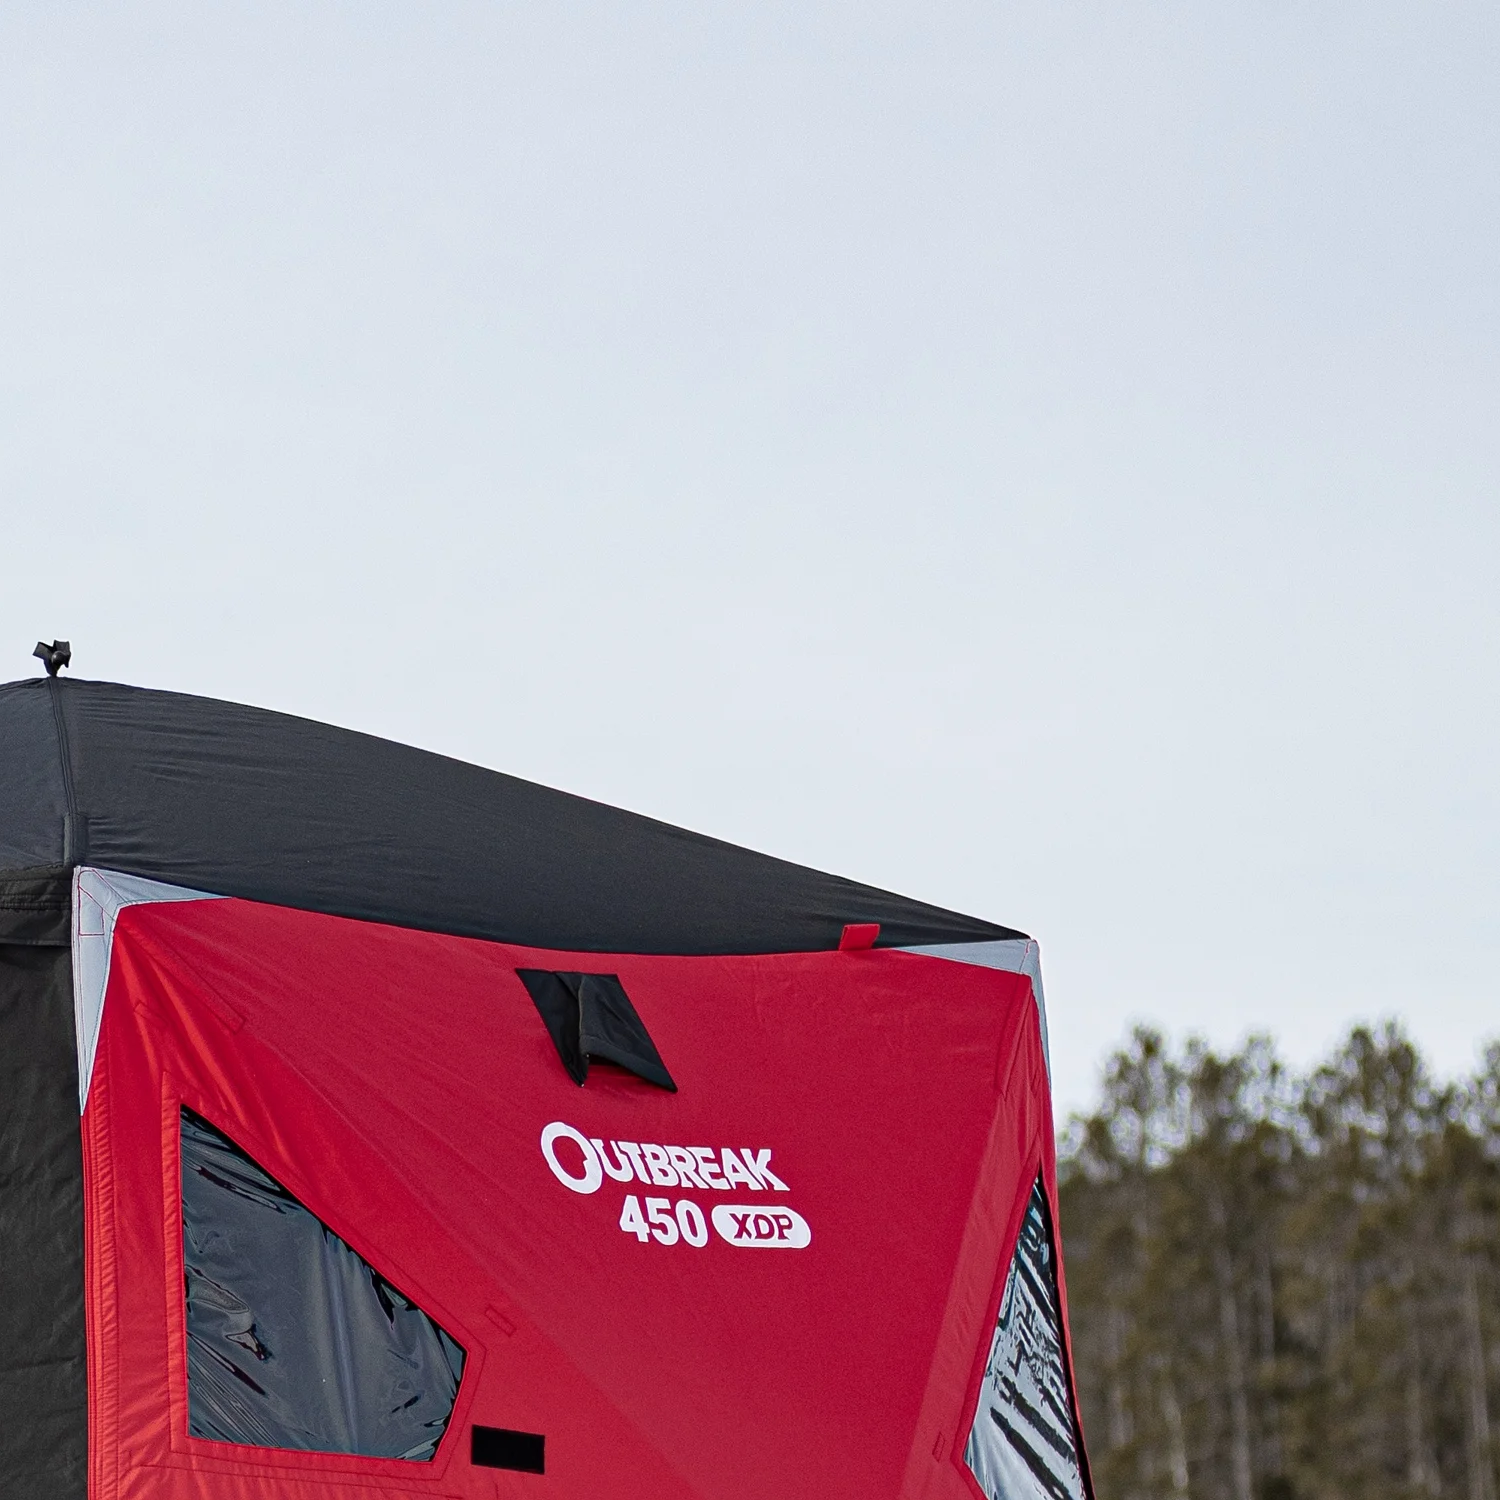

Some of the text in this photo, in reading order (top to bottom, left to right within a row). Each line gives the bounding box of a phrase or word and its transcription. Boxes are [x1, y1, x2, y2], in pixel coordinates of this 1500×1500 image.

[540, 1121, 791, 1194] OUTBREAK
[619, 1194, 796, 1248] 450 XDP
